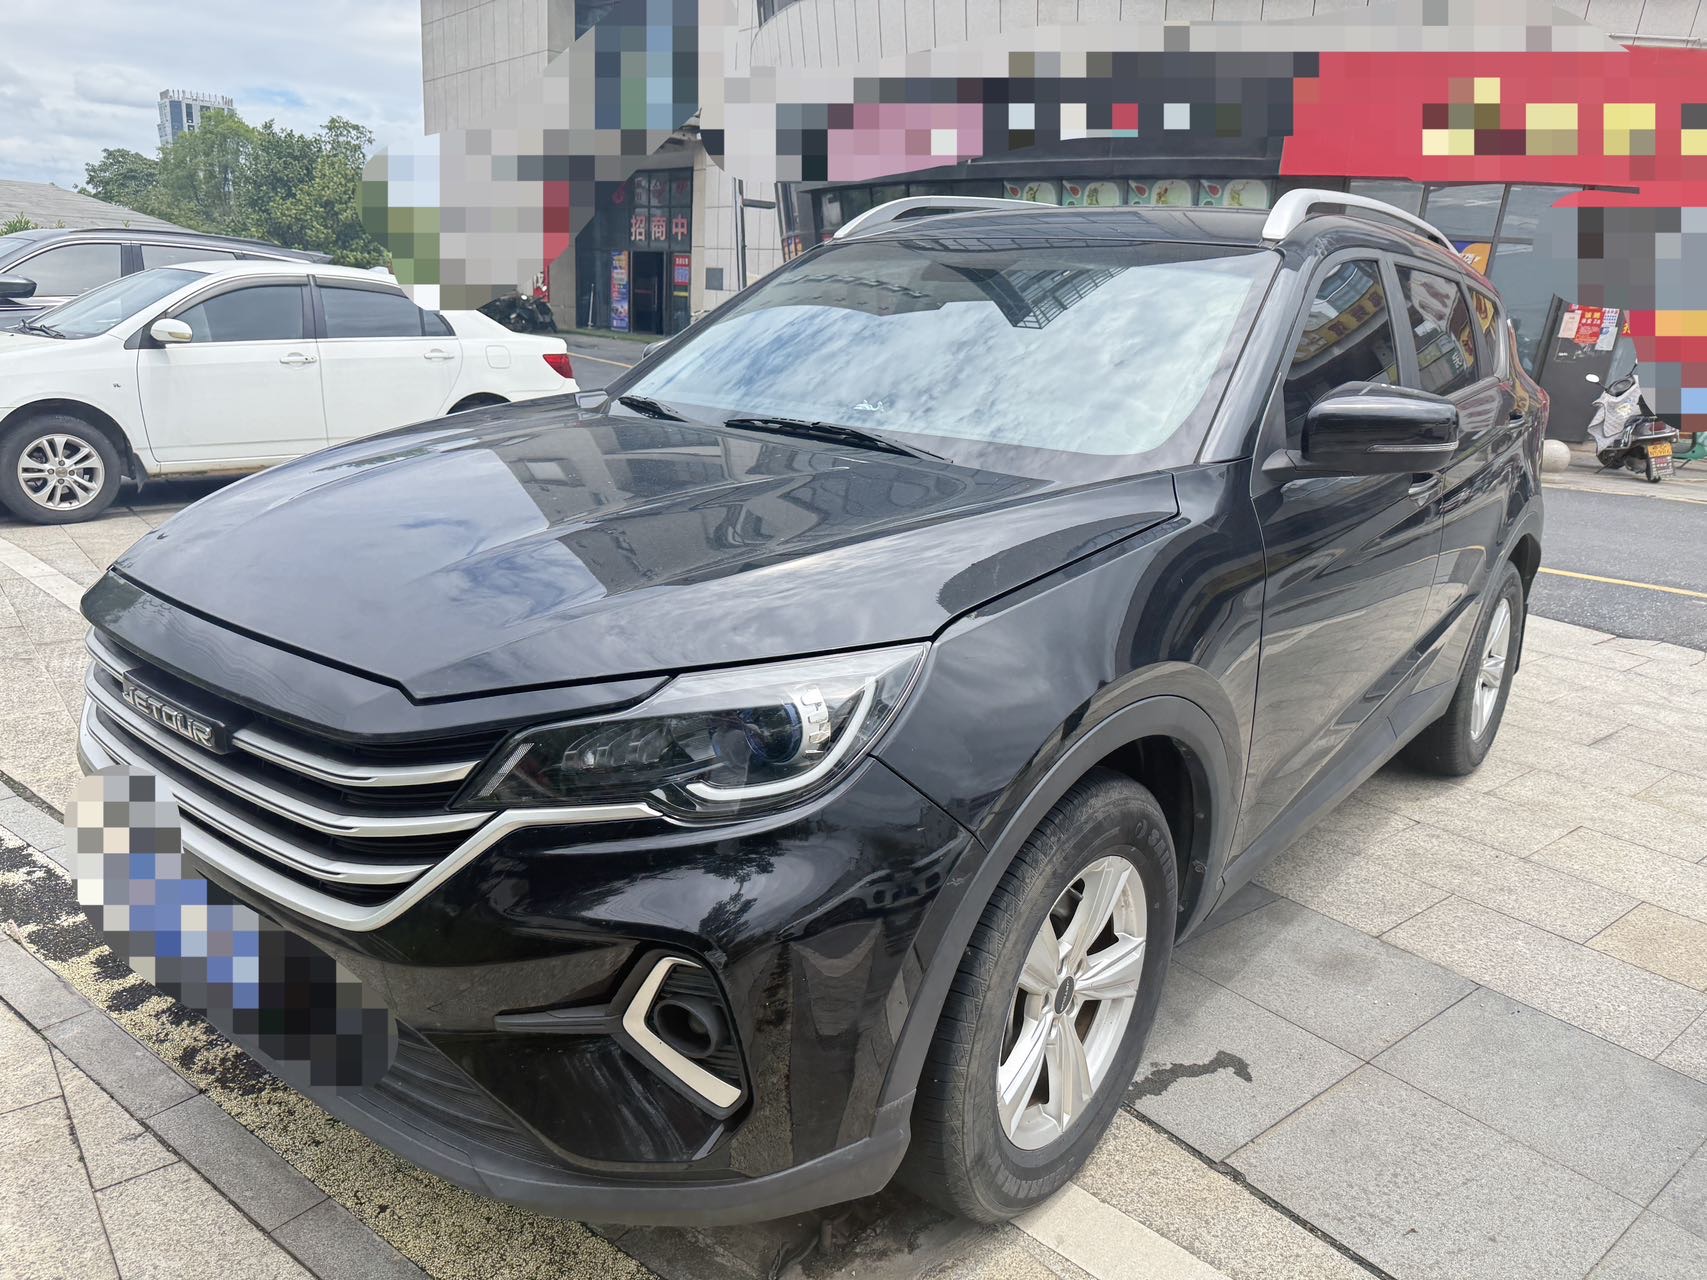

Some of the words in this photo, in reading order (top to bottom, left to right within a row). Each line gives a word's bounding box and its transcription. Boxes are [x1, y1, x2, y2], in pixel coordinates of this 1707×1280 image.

[631, 214, 688, 241] 招商中
[122, 687, 216, 747] JETOUR
